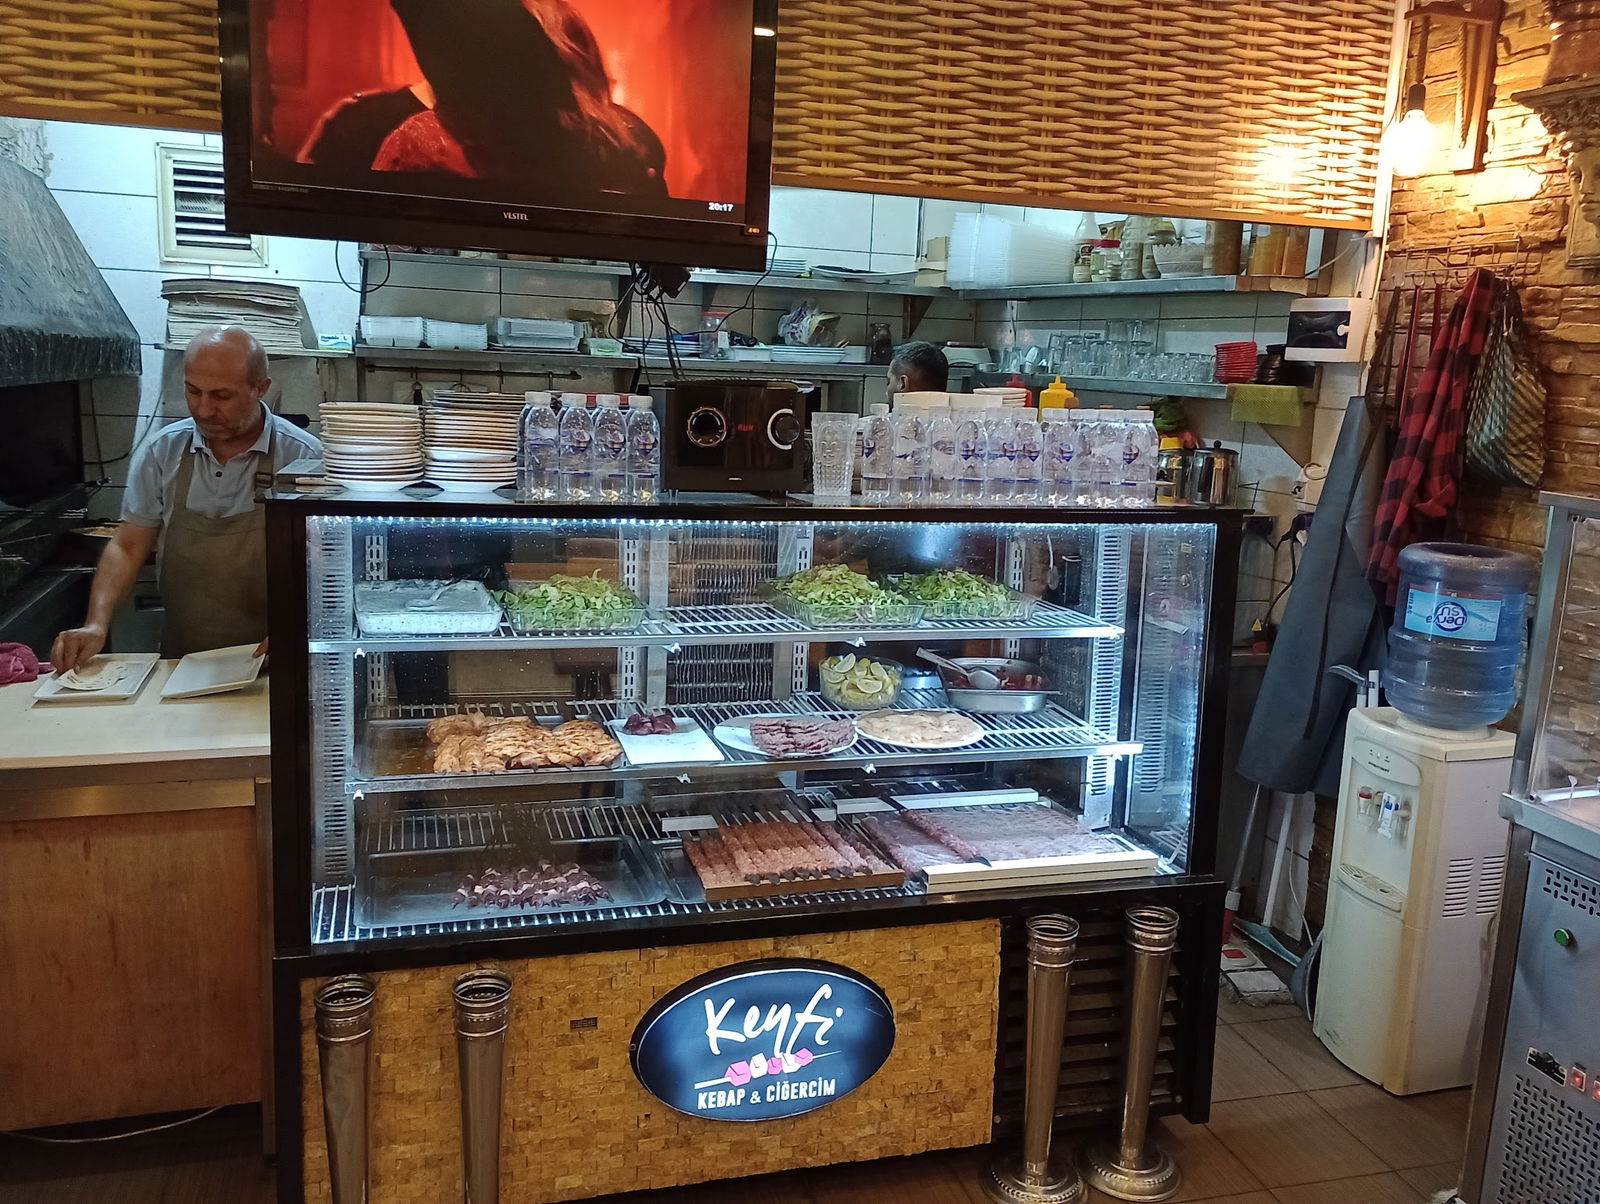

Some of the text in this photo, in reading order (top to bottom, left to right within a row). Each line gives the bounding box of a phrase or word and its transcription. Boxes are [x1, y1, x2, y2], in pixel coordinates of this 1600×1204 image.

[708, 202, 733, 212] 20:17
[502, 212, 529, 221] VESTEL
[1425, 614, 1465, 626] Derya
[704, 983, 843, 1055] Keyfi
[697, 1077, 835, 1109] KEBAP & CİĞERCİM
